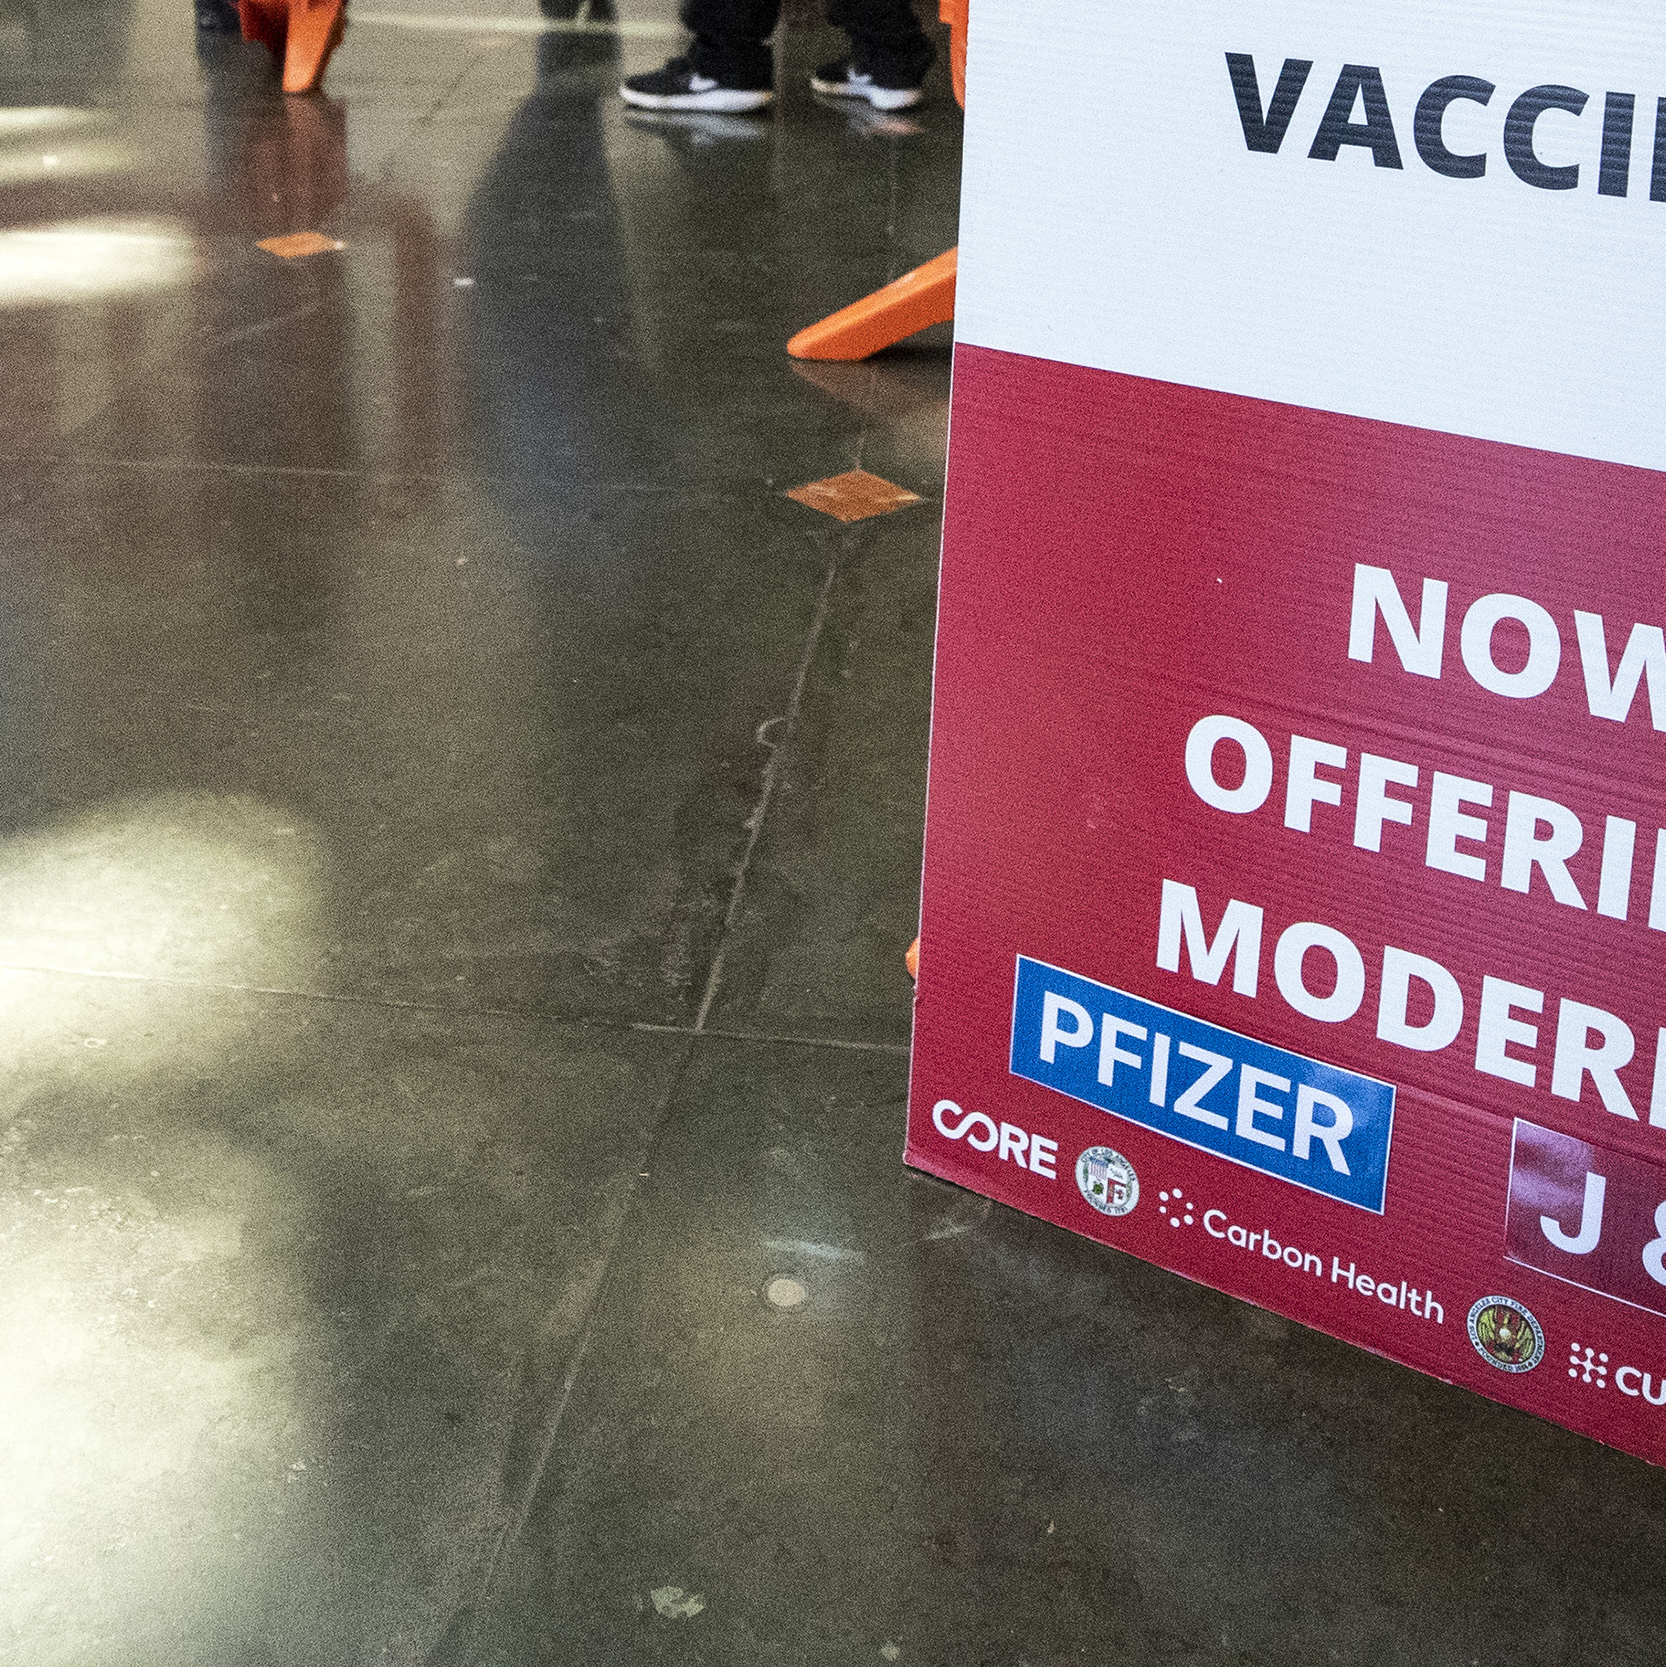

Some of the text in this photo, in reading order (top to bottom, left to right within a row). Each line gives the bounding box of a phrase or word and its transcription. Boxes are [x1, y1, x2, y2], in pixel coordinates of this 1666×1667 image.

[1039, 991, 1354, 1175] PFIZER
[932, 1099, 1059, 1180] CORE
[1539, 1170, 1607, 1255] J
[1203, 1208, 1444, 1324] Carbon Health
[1468, 1297, 1490, 1323] ANGELES
[1491, 1296, 1509, 1306] CITY
[1510, 1300, 1527, 1316] FIRE
